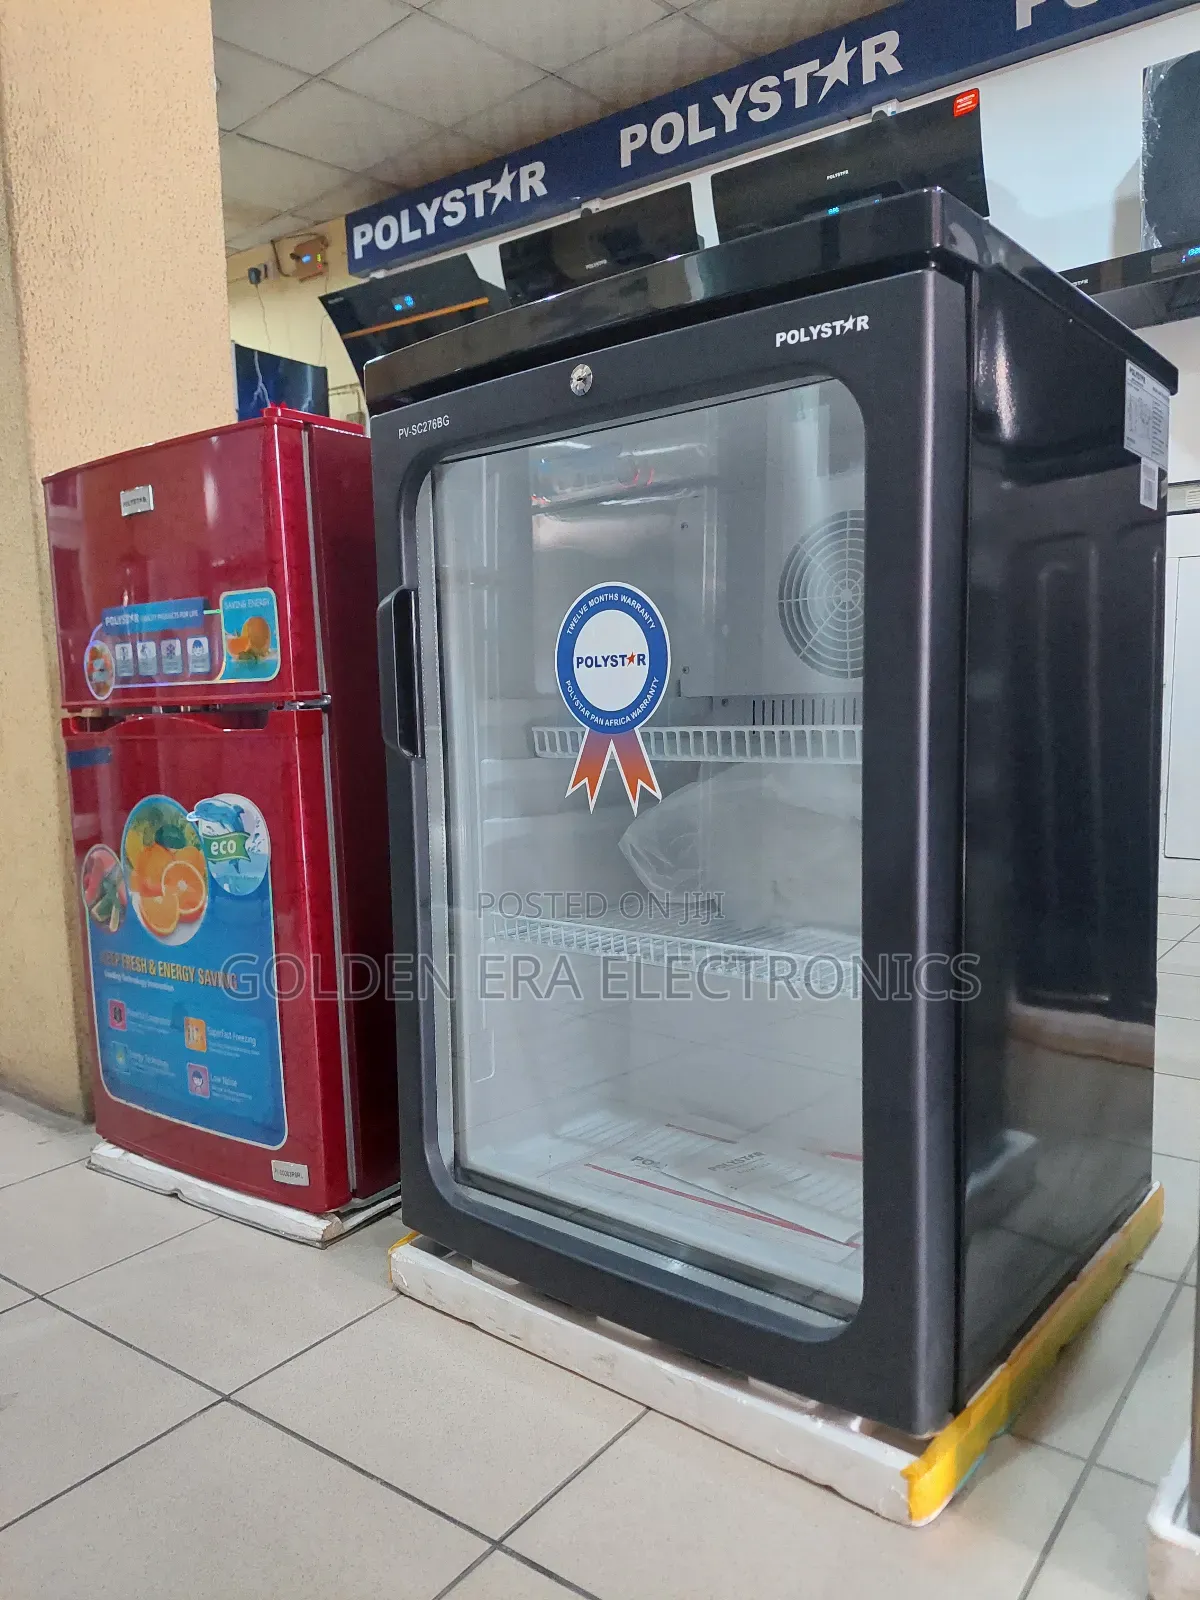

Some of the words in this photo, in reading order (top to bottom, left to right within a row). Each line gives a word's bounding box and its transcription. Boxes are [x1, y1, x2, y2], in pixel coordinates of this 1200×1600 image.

[398, 414, 450, 440] PV-SC276BG
[566, 604, 588, 635] TWELVE
[588, 593, 619, 608] MONTHS
[620, 593, 656, 630] WARRANTY
[565, 680, 591, 719] POLYSTAR
[590, 713, 604, 727] PAN
[604, 715, 632, 727] AFRICA
[630, 676, 660, 720] WARRANTY
[210, 839, 237, 856] eco
[121, 952, 148, 974] FRESH
[148, 959, 156, 976] &
[158, 960, 195, 983] ENERGY
[197, 967, 238, 990] SAVING
